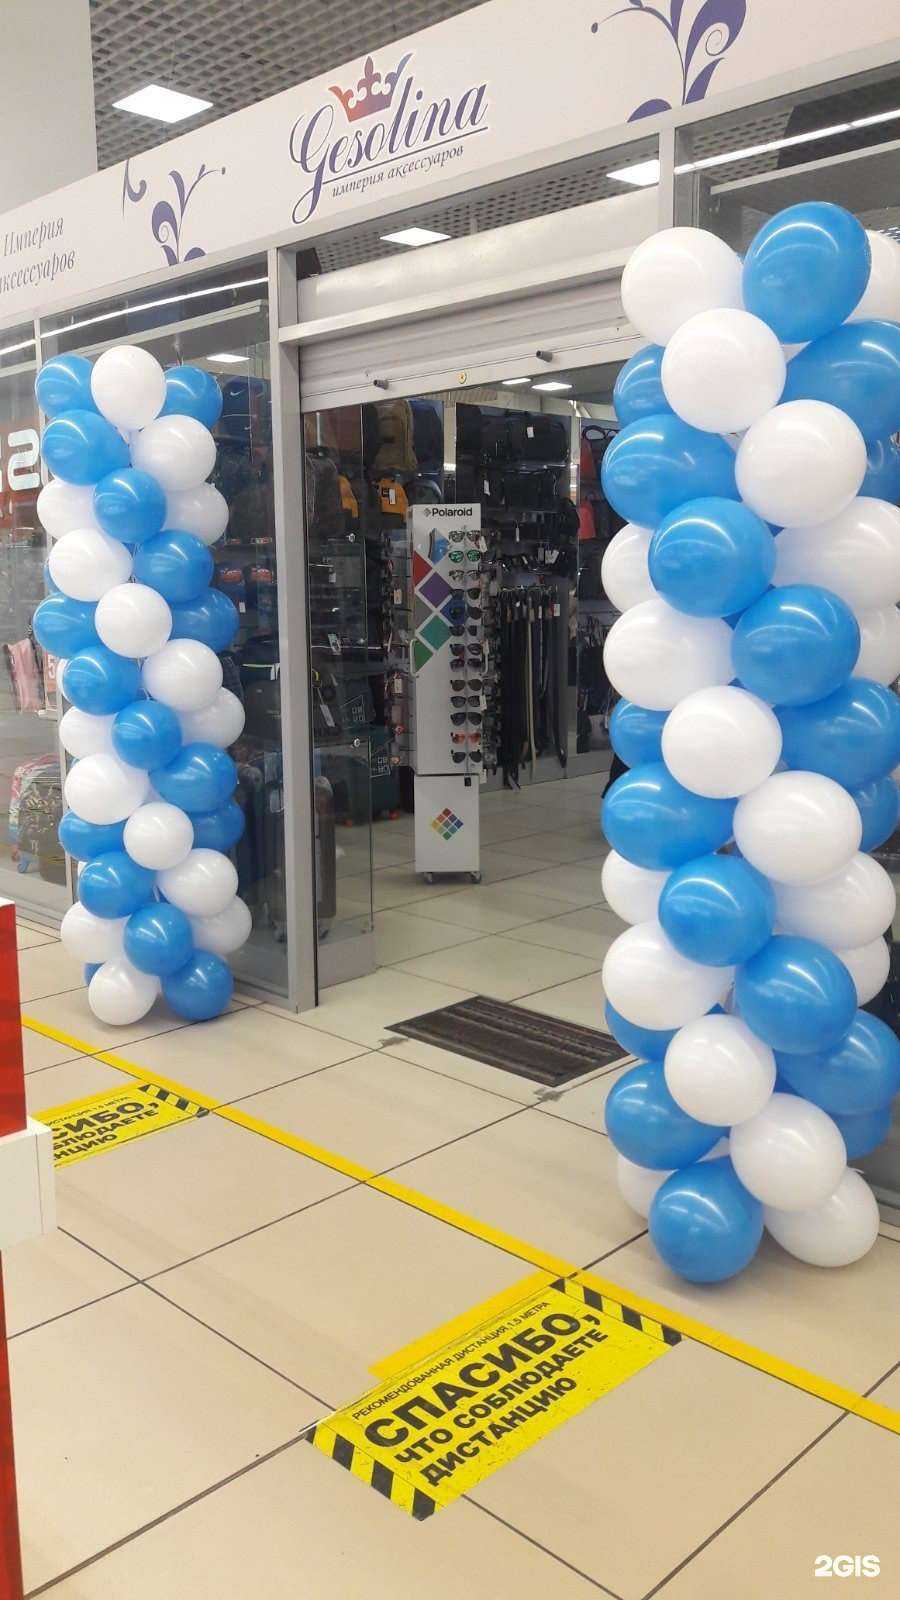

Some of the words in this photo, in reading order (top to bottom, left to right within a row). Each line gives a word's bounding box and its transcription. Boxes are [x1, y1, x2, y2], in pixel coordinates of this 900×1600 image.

[289, 75, 488, 224] Gesolina
[332, 171, 384, 198] империя
[387, 145, 464, 178] аксессуаров
[3, 217, 64, 256] Империя
[431, 507, 473, 517] Polaroid
[52, 1102, 159, 1140] СИБО,
[53, 1109, 159, 1151] БЛЮДАЕТЕ
[53, 1134, 118, 1160] НЦИЮ
[352, 1358, 453, 1421] РЕКОМЕНДОВАННАЯ
[453, 1326, 509, 1361] ДИСТАНЦИЯ
[521, 1301, 551, 1320] МЕТРА
[364, 1312, 601, 1448] СПАСИБО,
[394, 1428, 454, 1463] ЧТО
[453, 1328, 609, 1429] СОБЛЮДАЕТЕ
[419, 1377, 577, 1487] ДИСТАНЦИЮ
